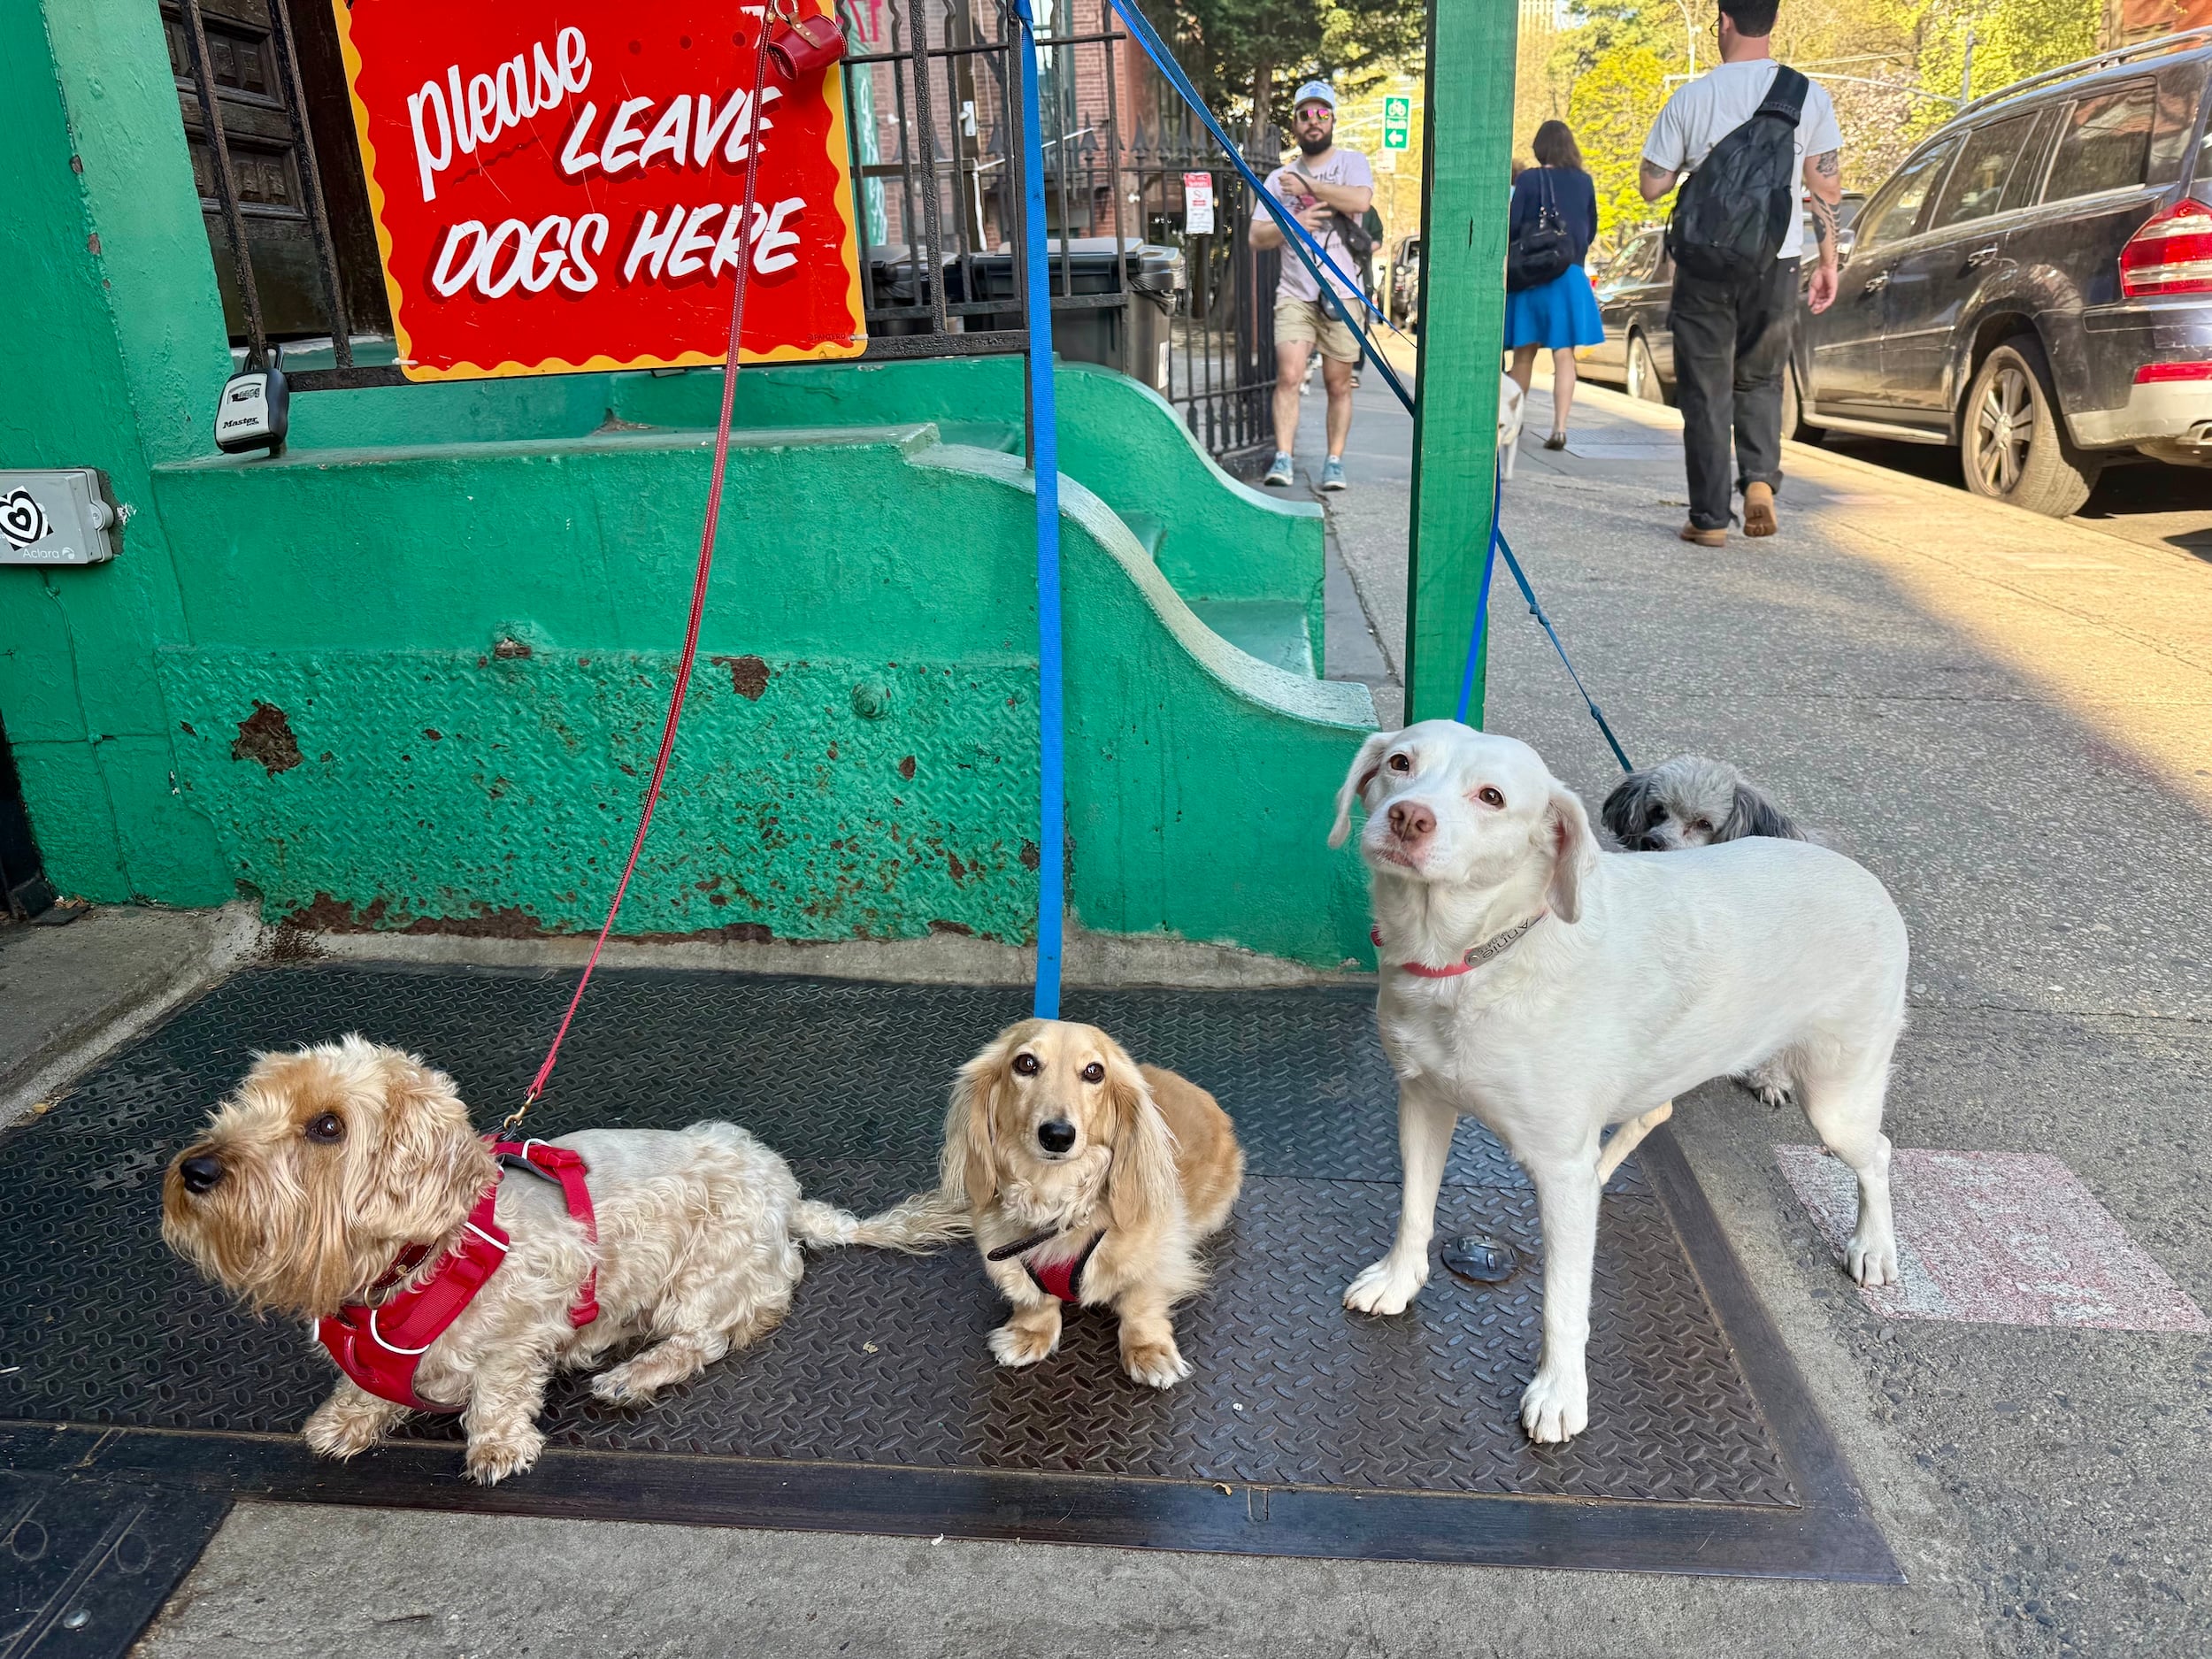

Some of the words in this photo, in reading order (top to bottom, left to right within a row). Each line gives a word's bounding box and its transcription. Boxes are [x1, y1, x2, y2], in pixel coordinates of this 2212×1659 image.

[407, 27, 592, 202] please
[561, 87, 784, 175] LEAVE
[432, 213, 610, 299] DOGS
[623, 197, 807, 283] HERE
[222, 417, 258, 429] Master
[22, 548, 60, 559] Aclara
[1482, 918, 1529, 958] Annie
